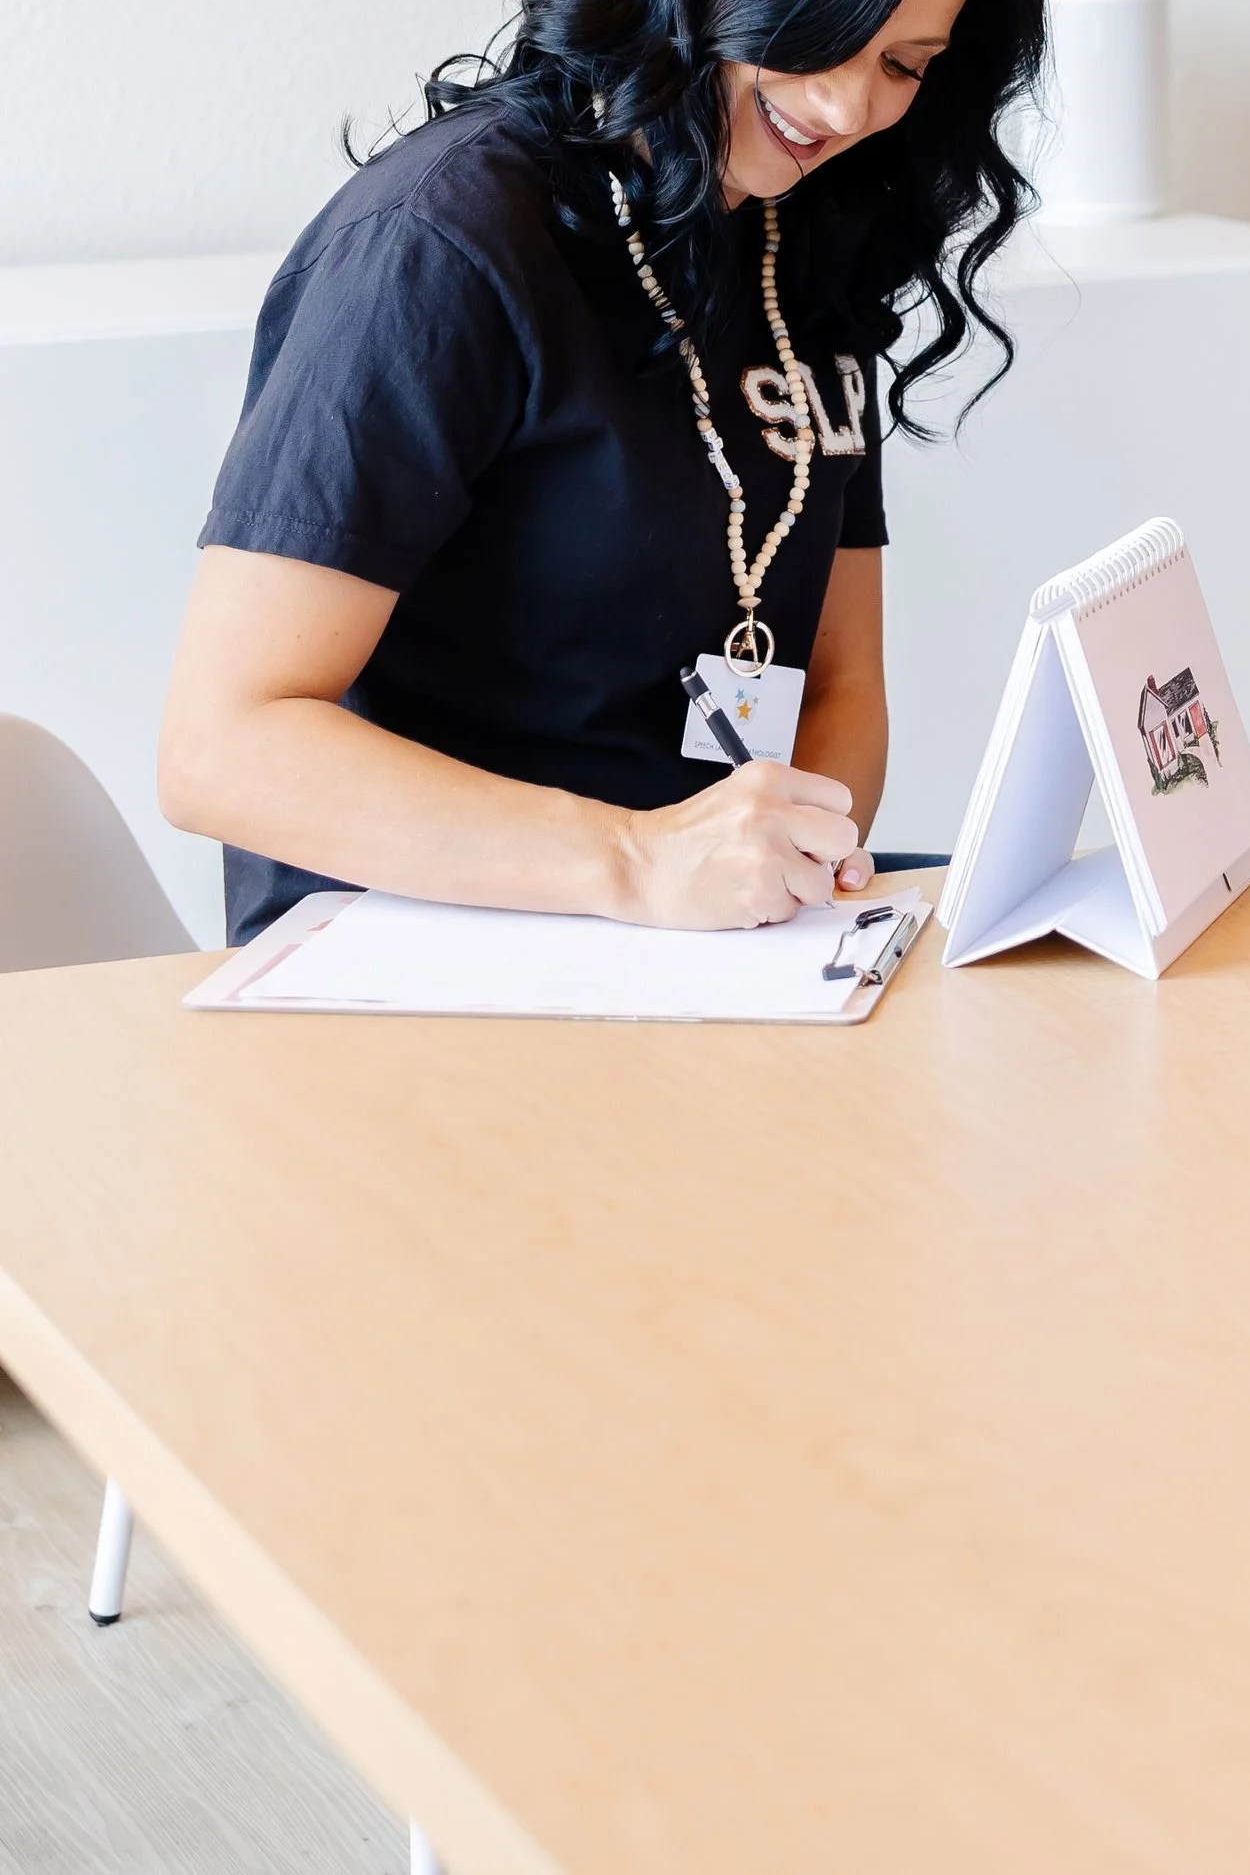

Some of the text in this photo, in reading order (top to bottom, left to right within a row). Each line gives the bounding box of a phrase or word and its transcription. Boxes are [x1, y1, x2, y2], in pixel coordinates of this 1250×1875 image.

[740, 353, 866, 462] SLP
[694, 741, 714, 750] SPEECH
[748, 748, 781, 759] ATHOLOGIST
